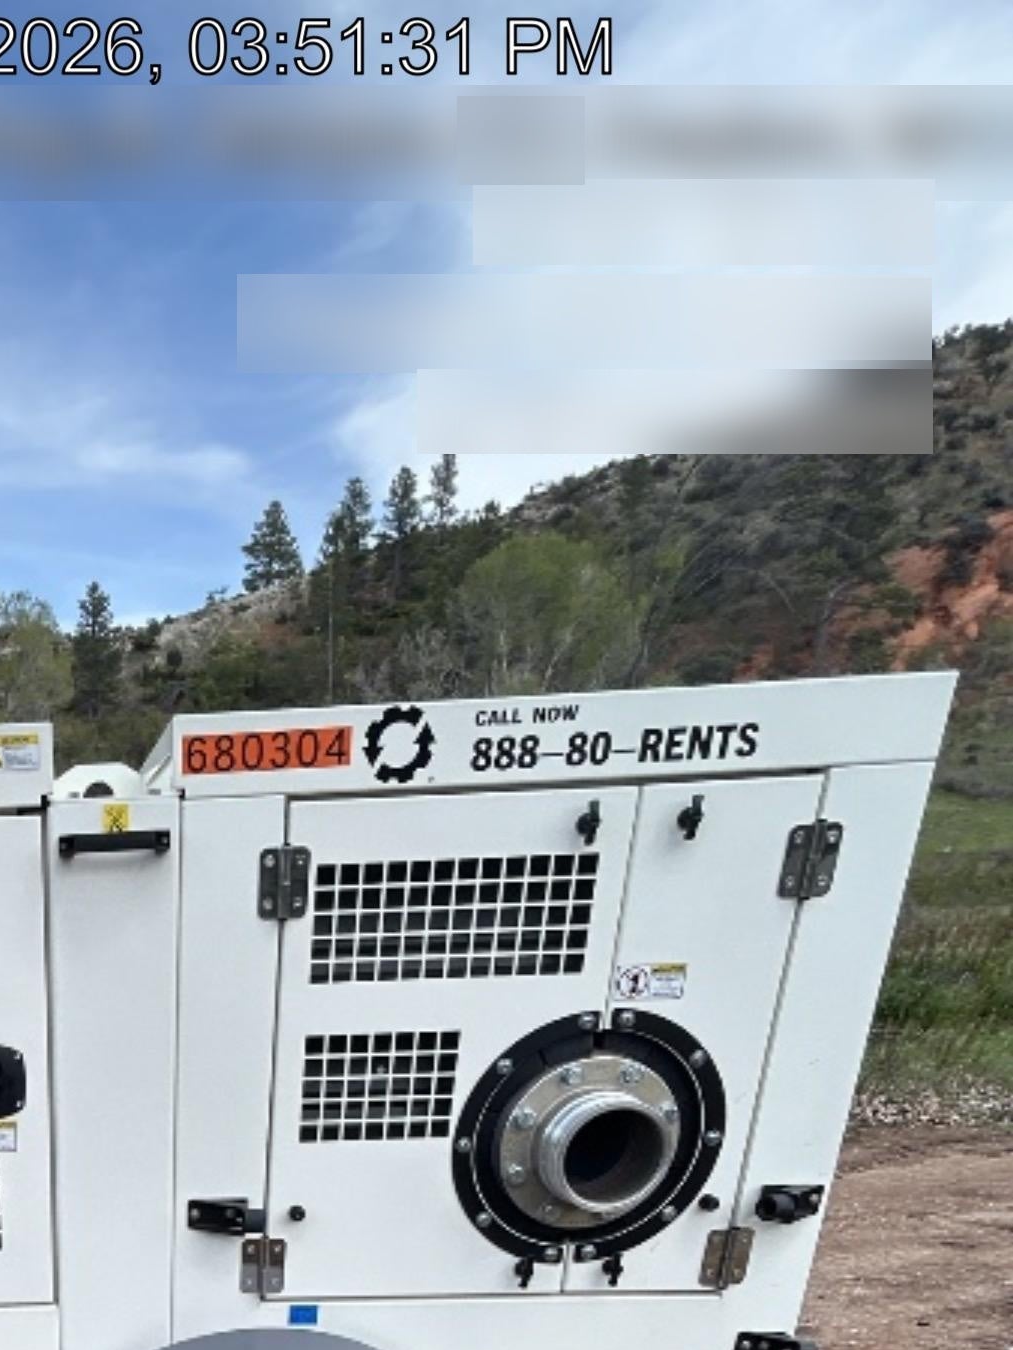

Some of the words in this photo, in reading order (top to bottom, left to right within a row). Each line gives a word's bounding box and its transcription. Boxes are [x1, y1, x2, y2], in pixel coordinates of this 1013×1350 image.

[475, 708, 522, 727] CALL
[532, 704, 580, 724] NOW
[187, 728, 347, 774] 680304
[470, 722, 759, 772] 888-80-RENTS
